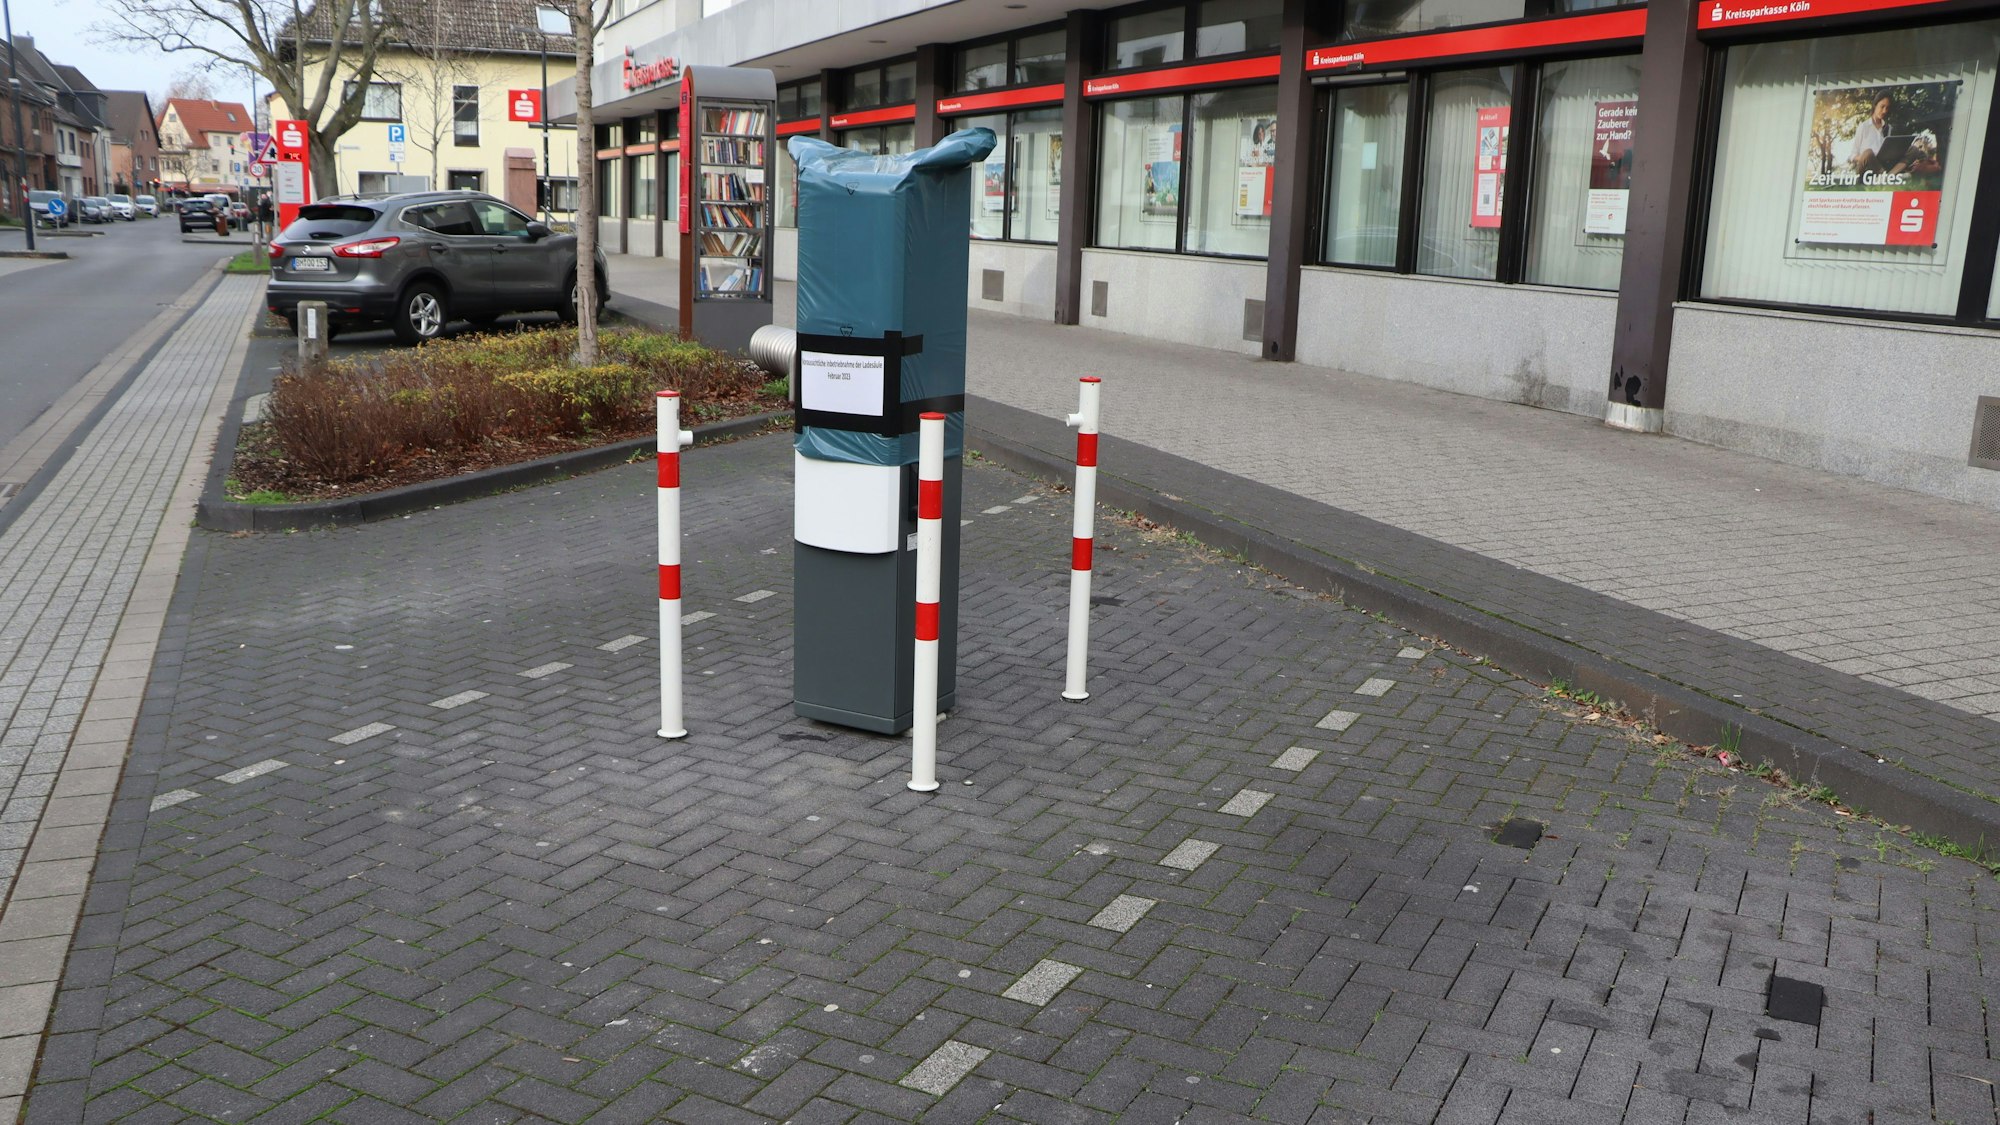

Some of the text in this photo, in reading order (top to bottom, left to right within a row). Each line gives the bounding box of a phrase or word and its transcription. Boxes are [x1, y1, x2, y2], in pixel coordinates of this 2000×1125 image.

[1725, 5, 1788, 20] Kreissparkasse
[1789, 1, 1811, 12] Köln
[1320, 55, 1353, 64] Kreissparkasse
[1598, 107, 1624, 117] Gerade
[1597, 119, 1630, 129] Zauberer
[1596, 130, 1632, 140] zur Hand?
[1809, 169, 1907, 186] Zeit für Gutes.
[862, 361, 883, 369] Ladesäule
[827, 372, 842, 380] Februar
